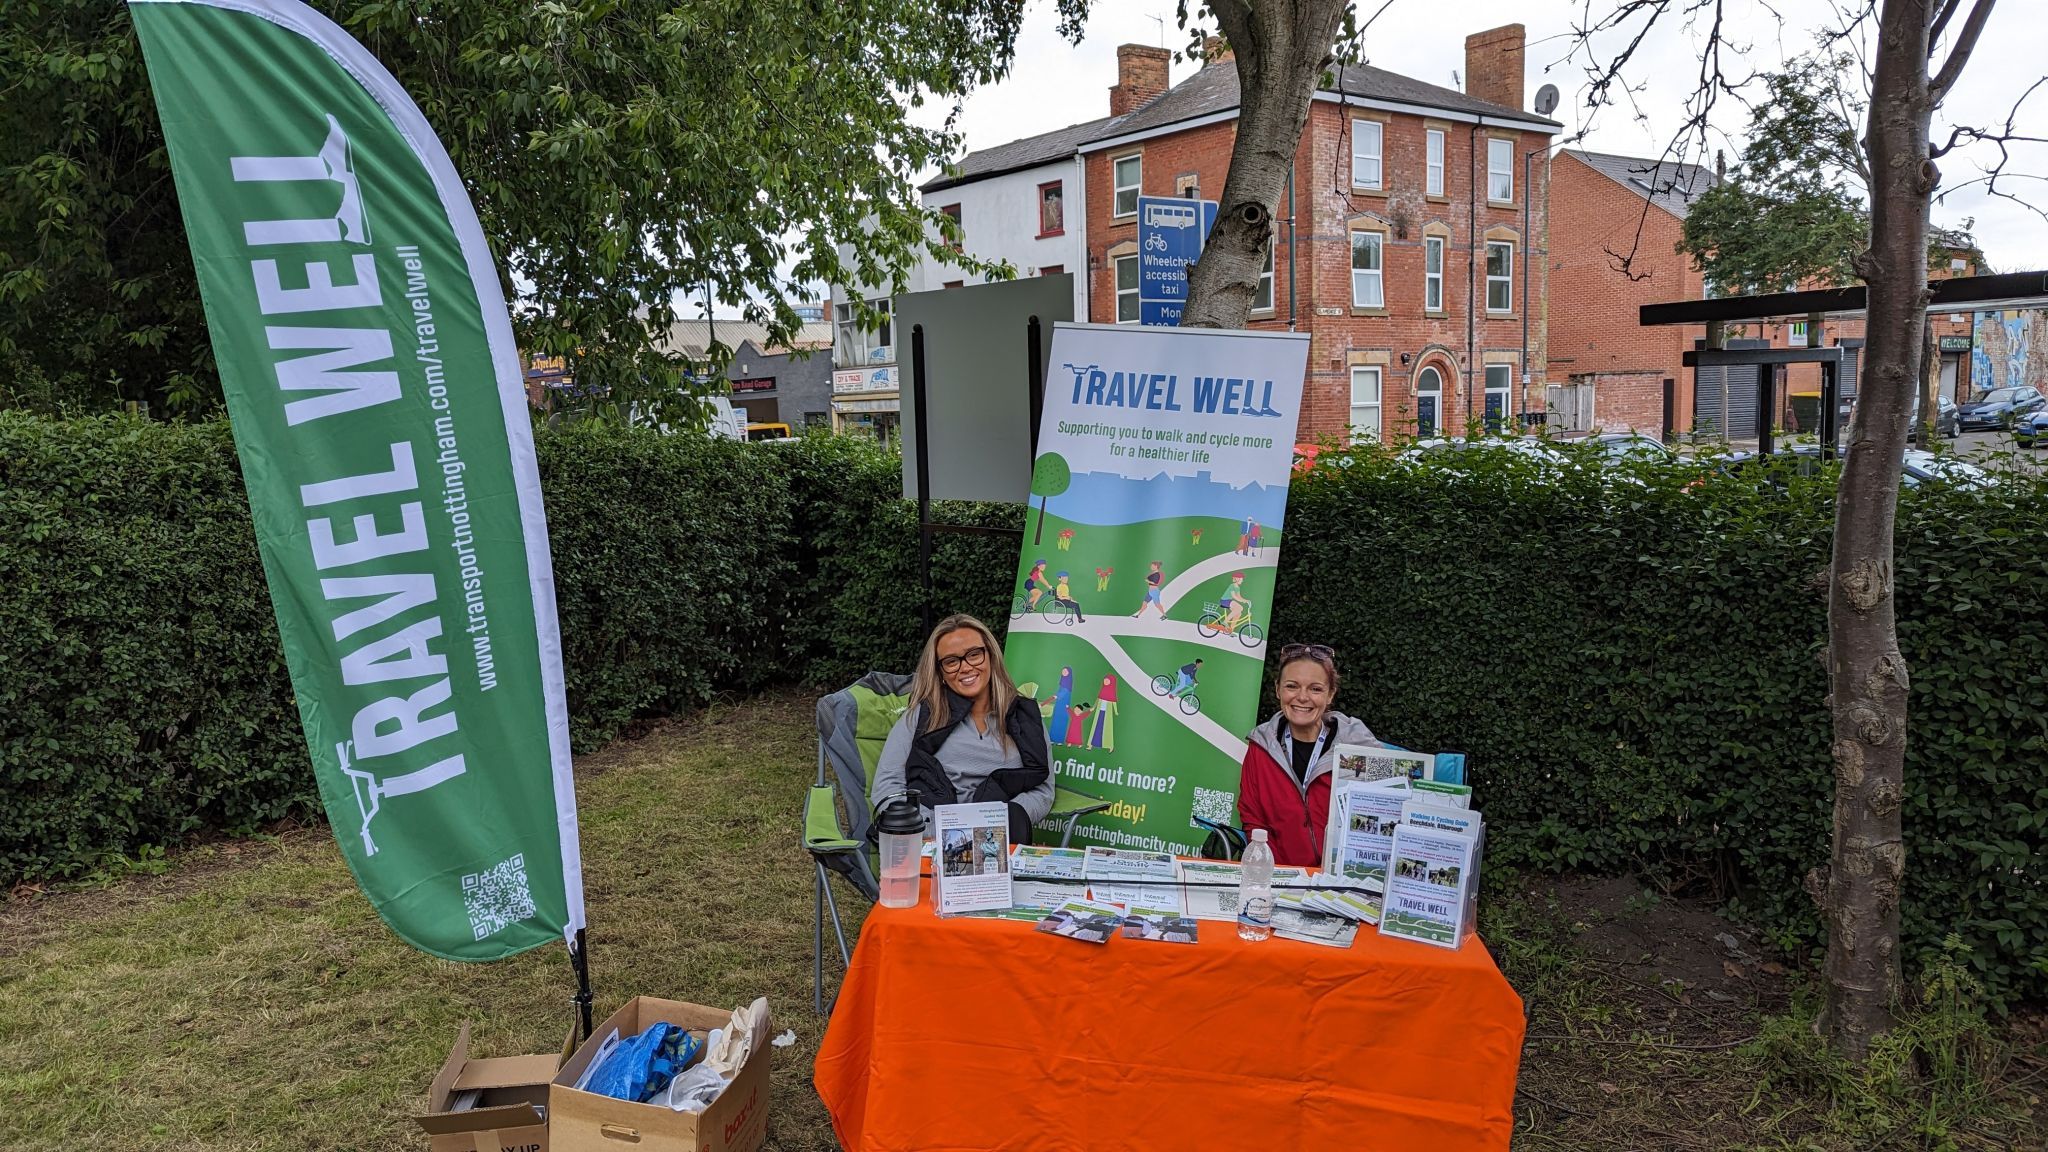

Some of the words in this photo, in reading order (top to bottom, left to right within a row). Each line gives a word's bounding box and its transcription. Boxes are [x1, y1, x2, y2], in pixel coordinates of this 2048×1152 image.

[230, 113, 402, 427] WELL
[1144, 254, 1195, 268] Wheelchair
[1145, 270, 1188, 281] accessibl
[1161, 283, 1179, 295] taxi
[1161, 307, 1181, 318] Mon
[1941, 337, 1971, 348] WELCOME
[1063, 363, 1182, 412] TRAVEL
[1193, 376, 1282, 417] WELL
[1058, 420, 1116, 440] Supporting
[1119, 427, 1139, 440] you
[1141, 426, 1153, 440] to
[1155, 427, 1182, 442] walk
[1186, 430, 1207, 445] and
[1209, 431, 1239, 448] cycle
[1242, 436, 1273, 449] more
[1109, 443, 1125, 457] for
[1128, 446, 1135, 458] a
[1138, 445, 1190, 463] healthier
[1192, 450, 1210, 463] life
[396, 245, 498, 692] www.transportnottingham.com/travelwell
[300, 441, 466, 856] TRAVEL
[1066, 757, 1094, 781] find
[1098, 767, 1123, 786] out
[1127, 771, 1177, 794] more?
[1410, 812, 1430, 821] Walking
[1436, 816, 1454, 826] Cycling
[1353, 849, 1380, 861] TRAVEL
[1398, 896, 1425, 912] TRAVEL
[1427, 904, 1449, 916] WELL
